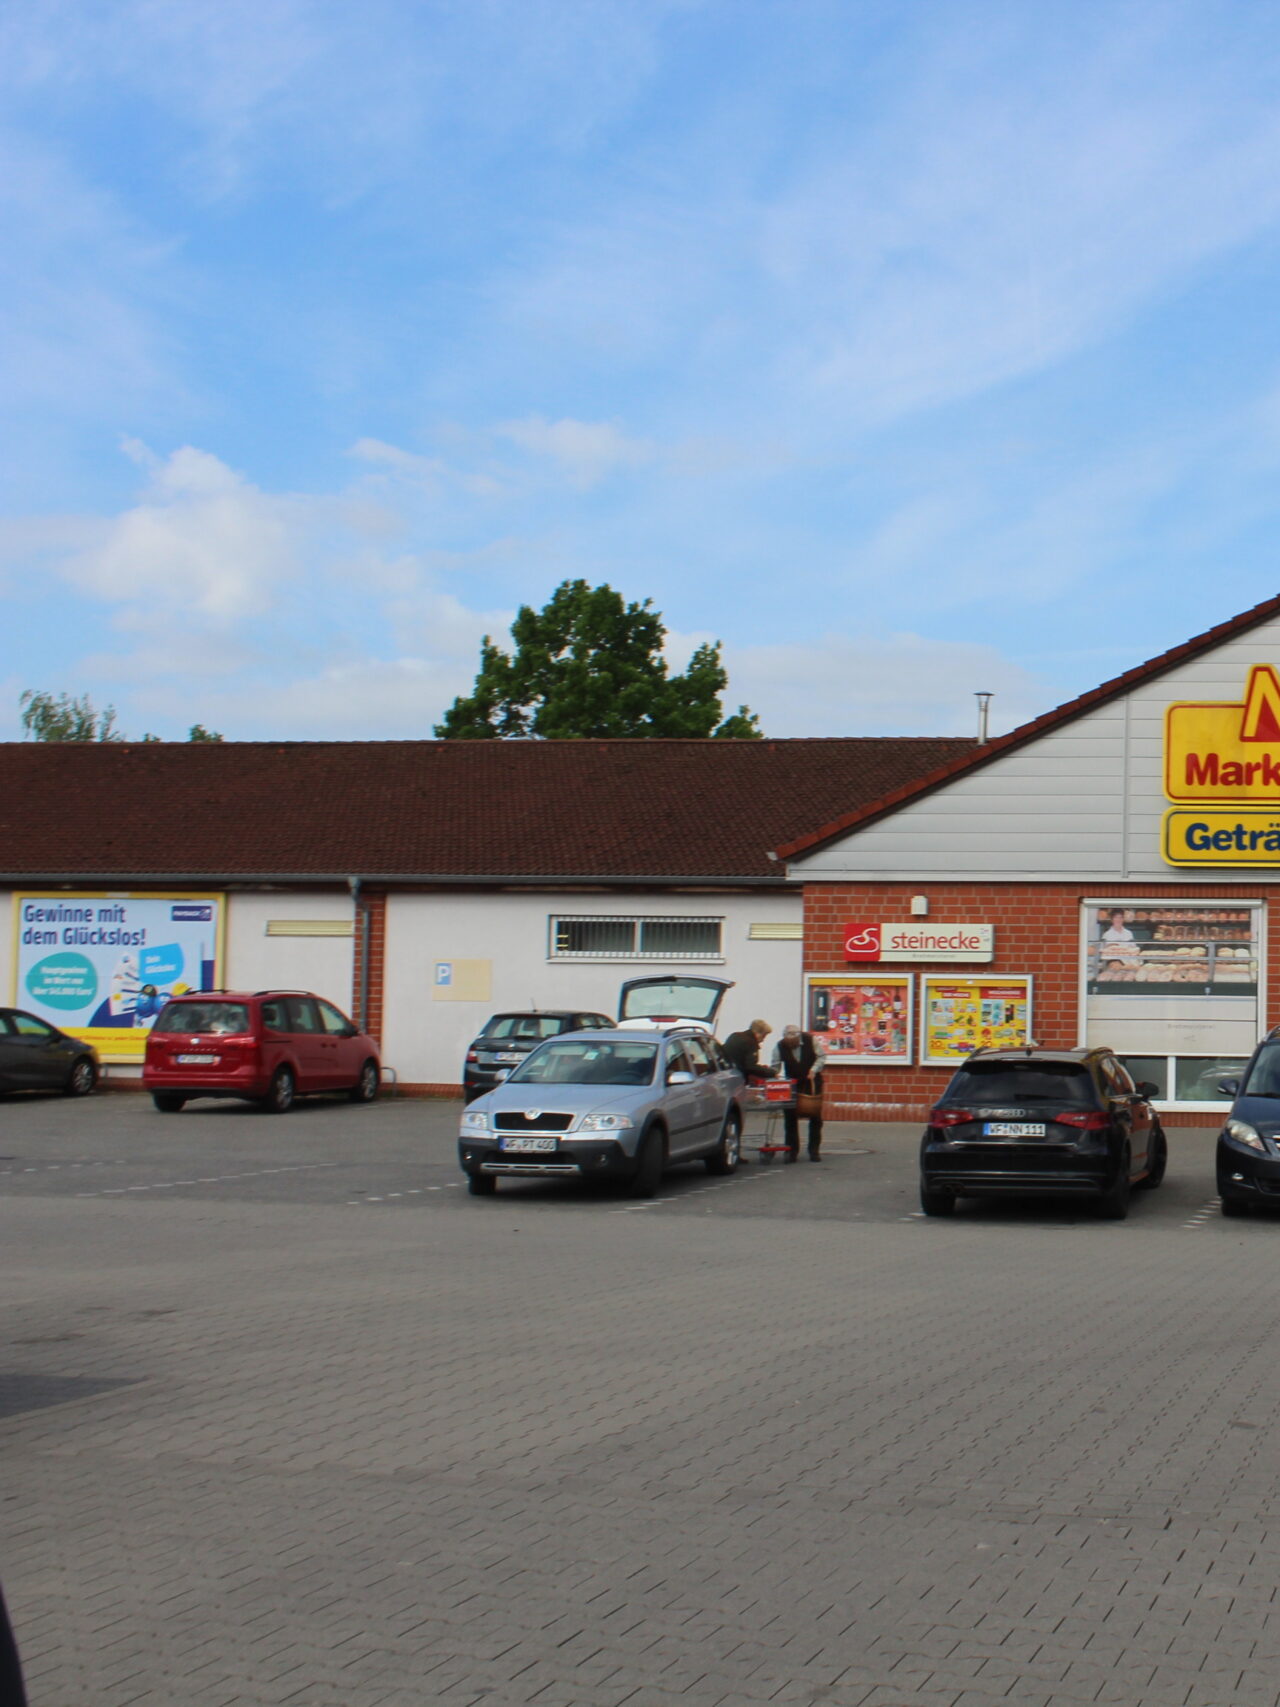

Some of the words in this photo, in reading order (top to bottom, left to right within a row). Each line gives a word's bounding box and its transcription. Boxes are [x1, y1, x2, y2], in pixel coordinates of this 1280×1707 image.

[23, 904, 93, 924] Gewinne
[97, 904, 126, 924] mit
[22, 927, 58, 946] dem
[62, 926, 147, 947] Glückslos!
[890, 930, 981, 950] steinecke
[438, 965, 450, 984] P
[1024, 1124, 1045, 1135] 111
